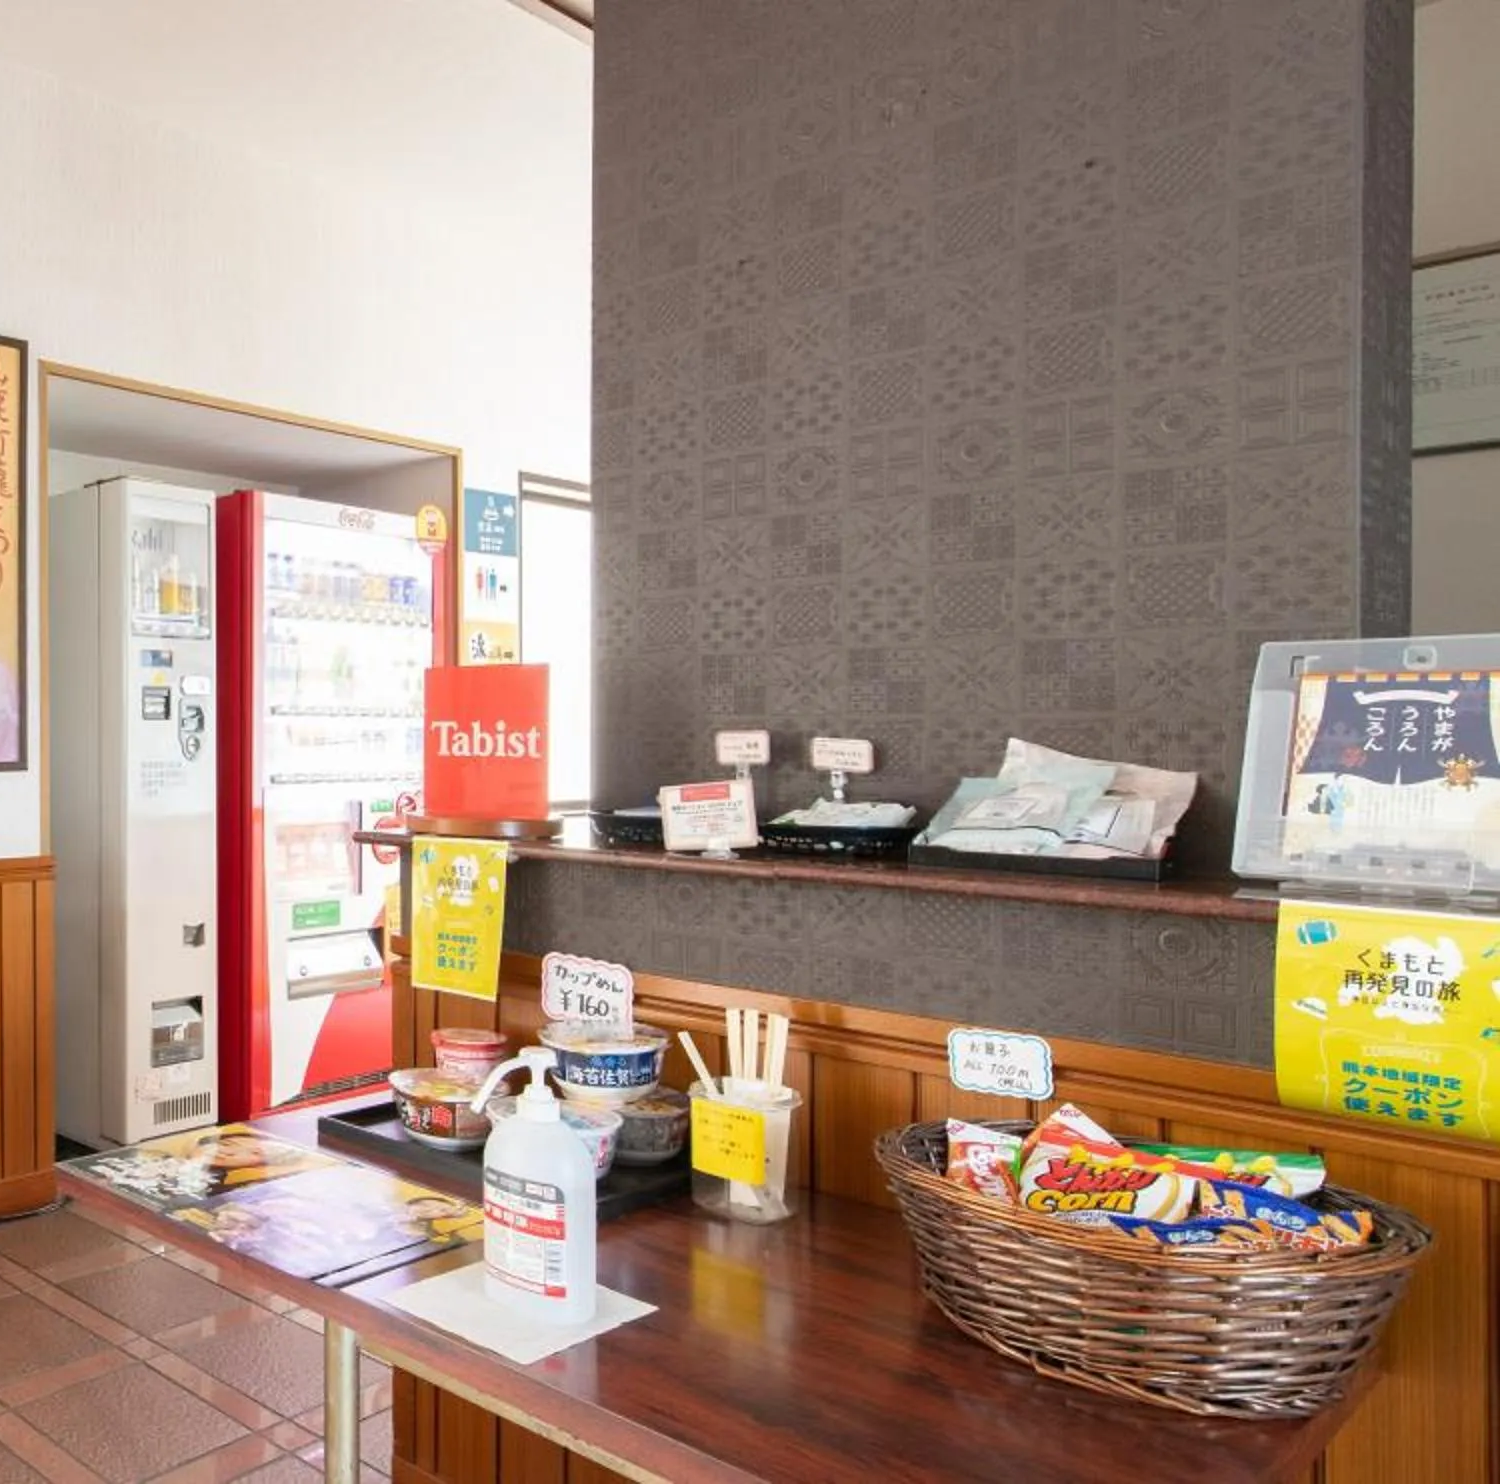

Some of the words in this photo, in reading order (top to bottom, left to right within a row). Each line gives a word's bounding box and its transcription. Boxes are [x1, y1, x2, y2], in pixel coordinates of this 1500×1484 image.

[431, 719, 541, 758] Tabist
[1363, 707, 1388, 751] ころん
[1397, 706, 1420, 752] うろん
[1432, 706, 1457, 751] やまが
[1357, 948, 1445, 976] くまもと
[554, 964, 624, 993] カップめん
[1344, 969, 1461, 1002] 再発見の旅
[1342, 1061, 1463, 1091] 熊本地域限定
[1344, 1078, 1463, 1109] クーポン
[1345, 1096, 1464, 1127] 使えます
[1026, 1189, 1138, 1214] Corn
